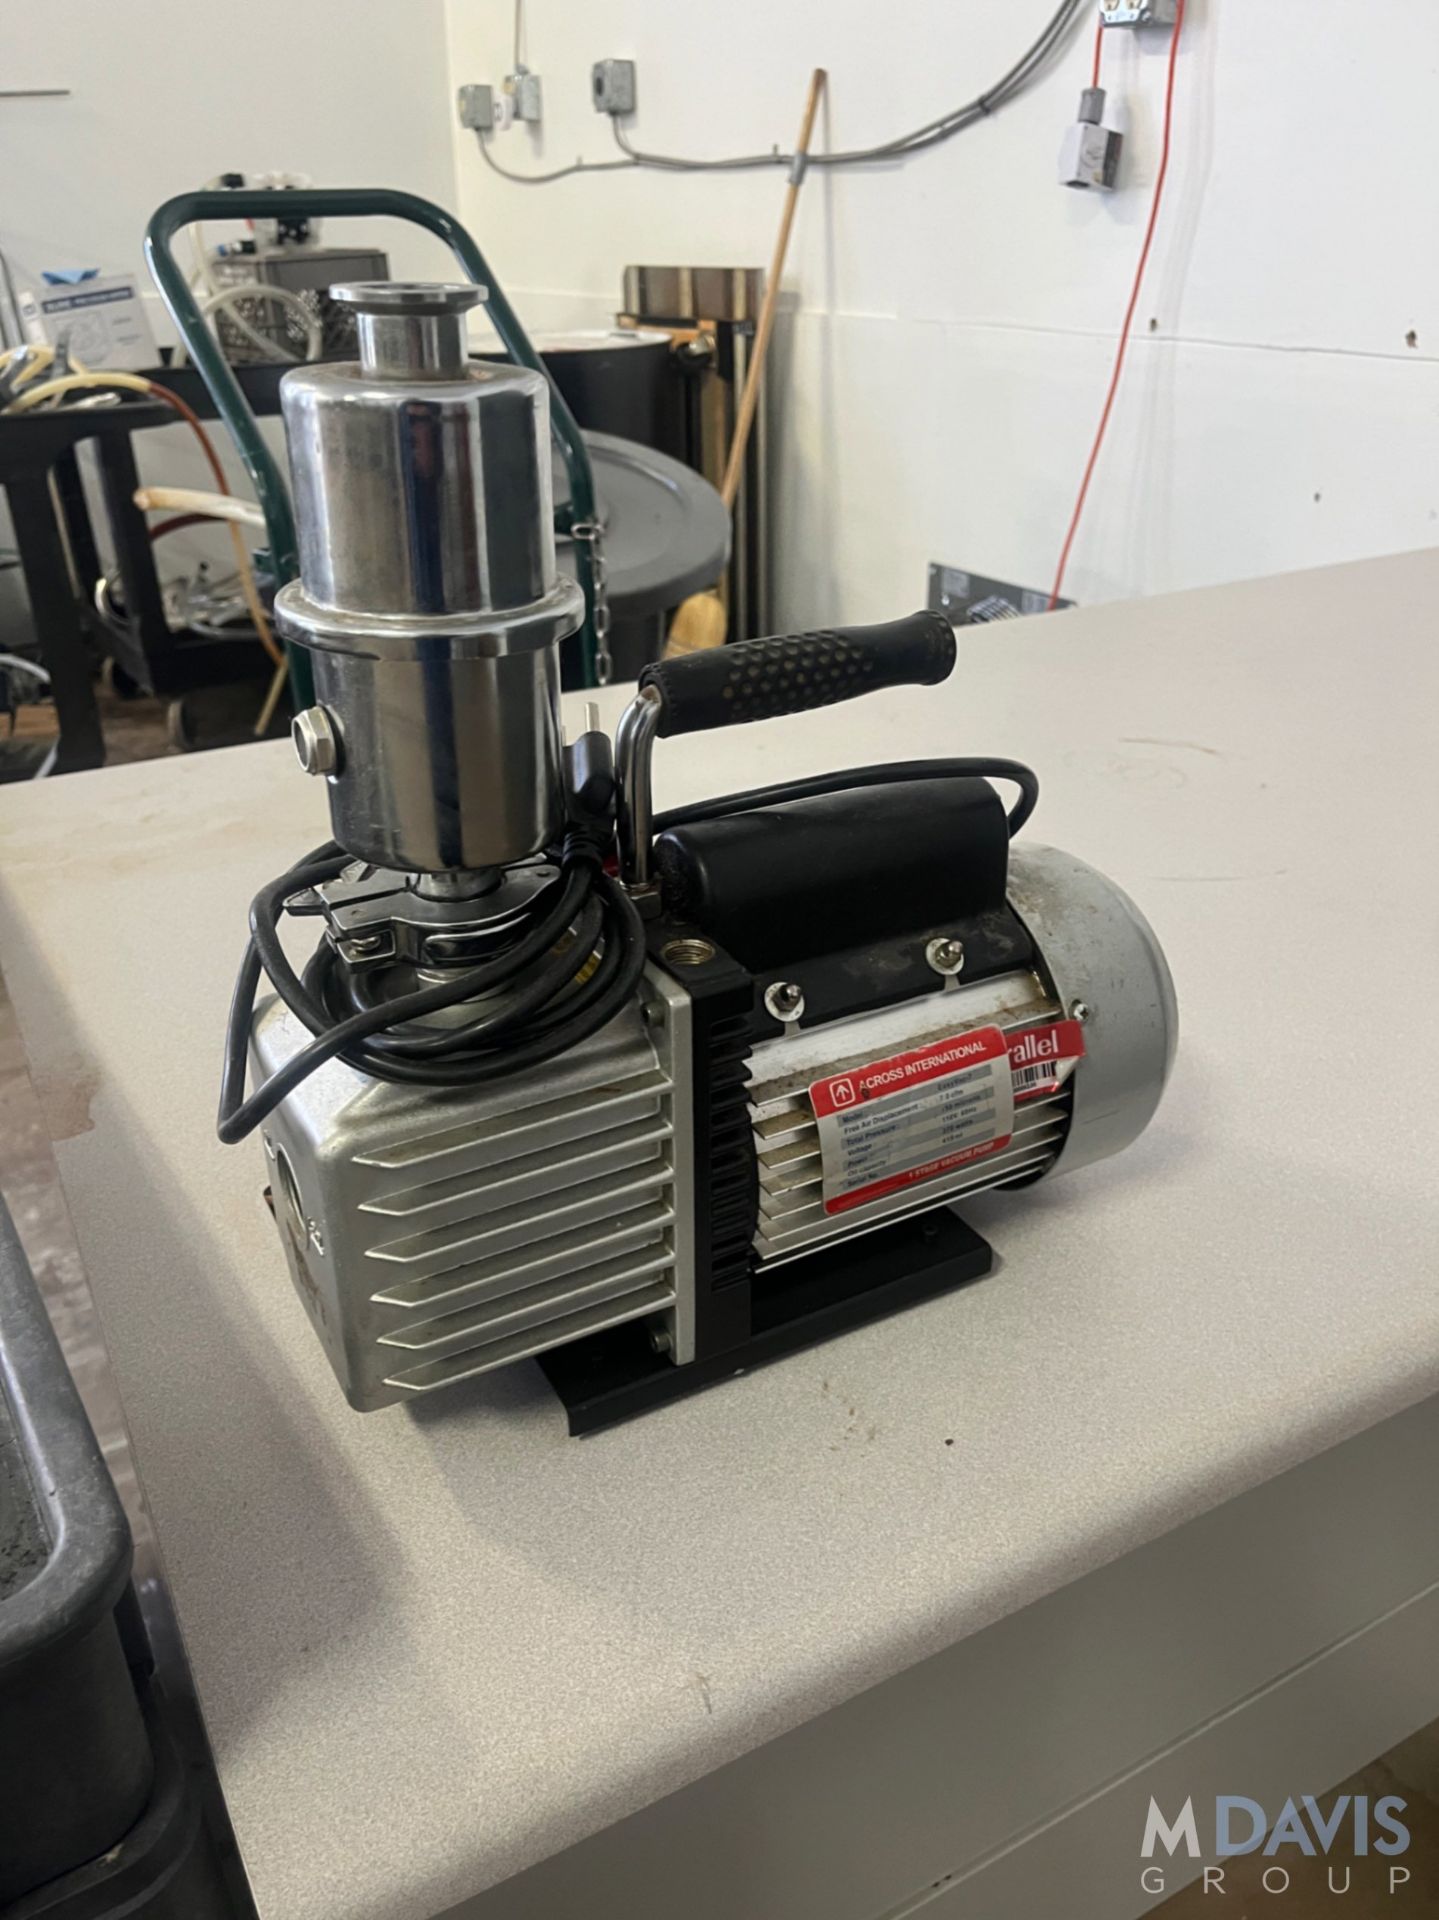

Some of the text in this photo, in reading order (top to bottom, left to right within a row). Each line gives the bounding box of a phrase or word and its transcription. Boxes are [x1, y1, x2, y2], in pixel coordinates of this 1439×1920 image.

[860, 1041, 987, 1090] ACROSS INTERNATIONAL
[844, 1124, 860, 1134] Free
[861, 1120, 872, 1128] Air
